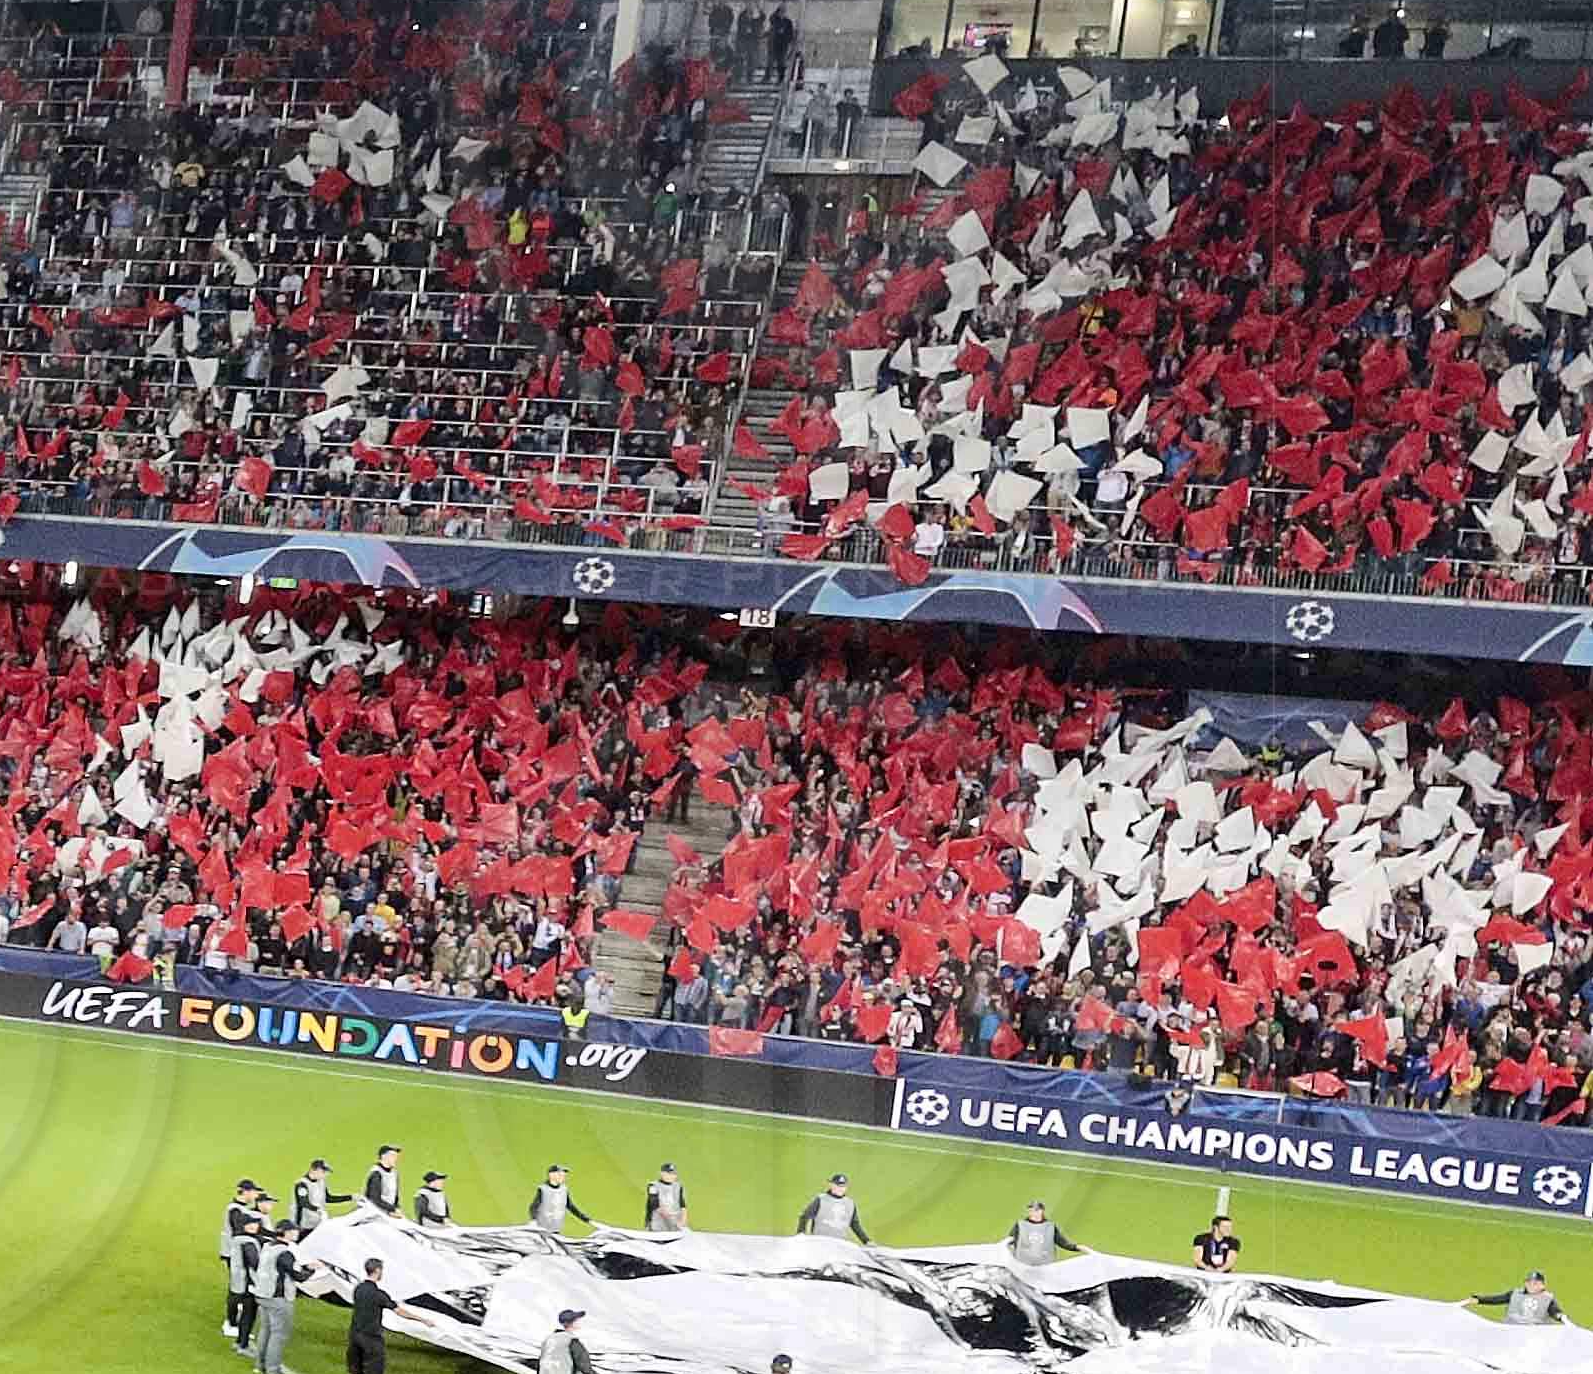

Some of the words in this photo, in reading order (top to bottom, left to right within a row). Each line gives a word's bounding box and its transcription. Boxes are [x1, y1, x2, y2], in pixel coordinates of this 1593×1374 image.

[746, 608, 771, 625] 18
[42, 975, 171, 1030] UEFA
[565, 1045, 649, 1083] .org
[959, 1101, 1069, 1141] UEFA
[1077, 1112, 1337, 1174] CHAMPIONS
[1349, 1145, 1522, 1198] LEAGUE
